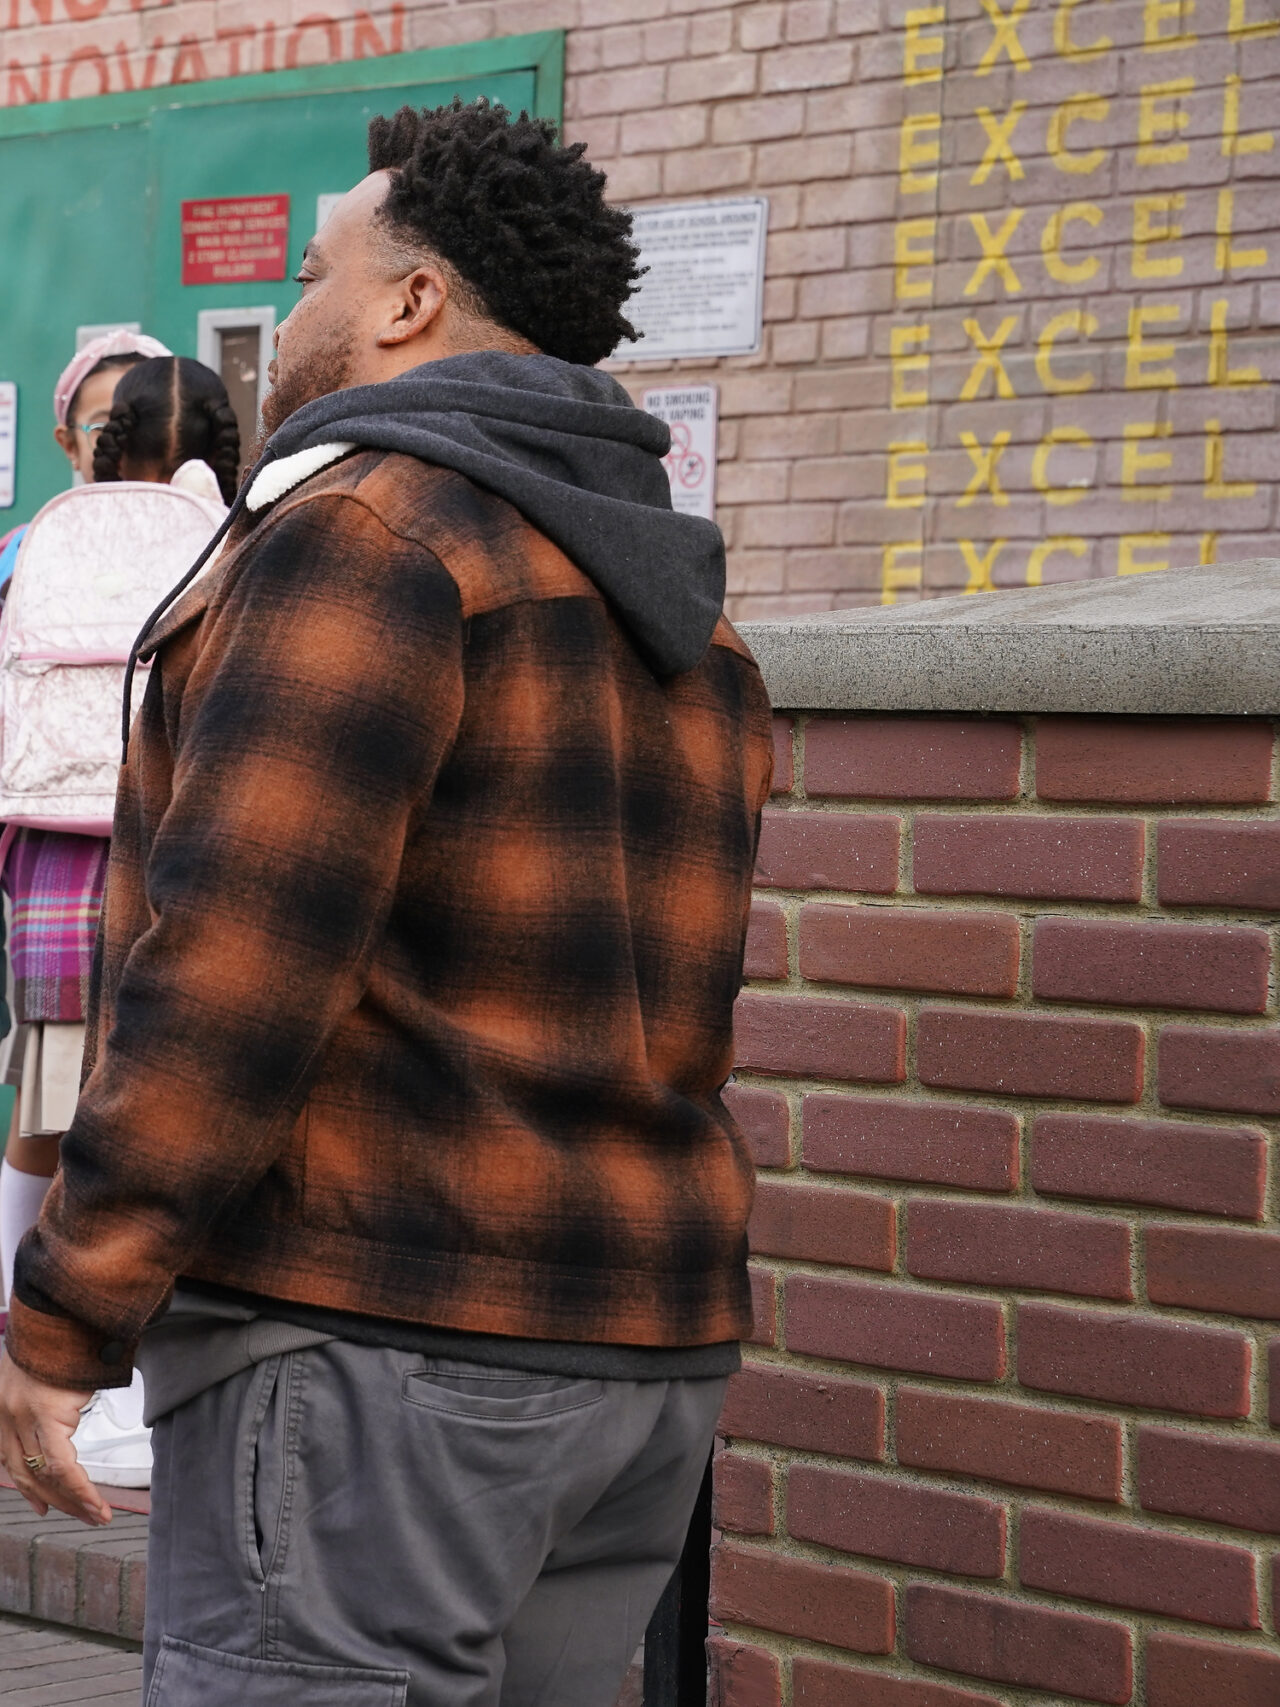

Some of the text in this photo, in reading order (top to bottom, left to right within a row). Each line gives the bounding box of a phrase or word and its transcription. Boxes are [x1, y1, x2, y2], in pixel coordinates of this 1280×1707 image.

[899, 75, 1275, 195] EXCEL
[894, 189, 1268, 300] EXCEL
[648, 392, 710, 407] NO SMOKING
[890, 299, 1266, 411] EXCEL
[885, 419, 1257, 509] EXCEL
